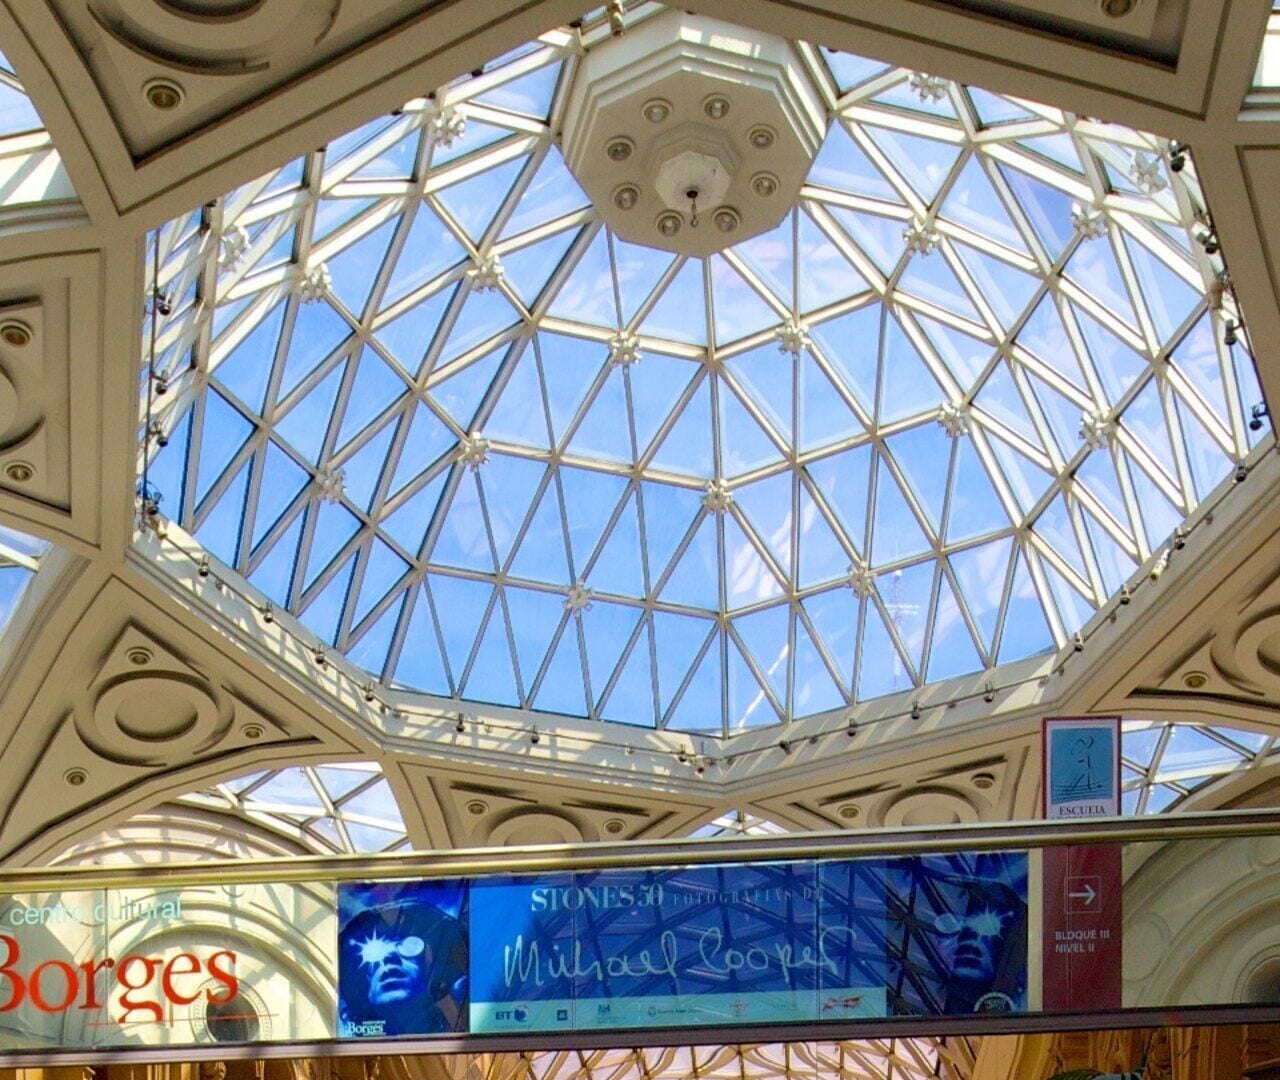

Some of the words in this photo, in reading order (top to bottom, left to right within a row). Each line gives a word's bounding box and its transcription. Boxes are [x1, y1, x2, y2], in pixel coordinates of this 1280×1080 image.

[531, 885, 636, 912] STONES
[637, 883, 664, 908] 50
[9, 902, 89, 926] centro
[93, 895, 182, 923] cultural
[1055, 930, 1097, 941] BLOQUE
[504, 930, 678, 988] Michael
[699, 926, 857, 984] Cooper
[1055, 943, 1085, 953] NIVEL
[495, 1010, 513, 1020] BT
